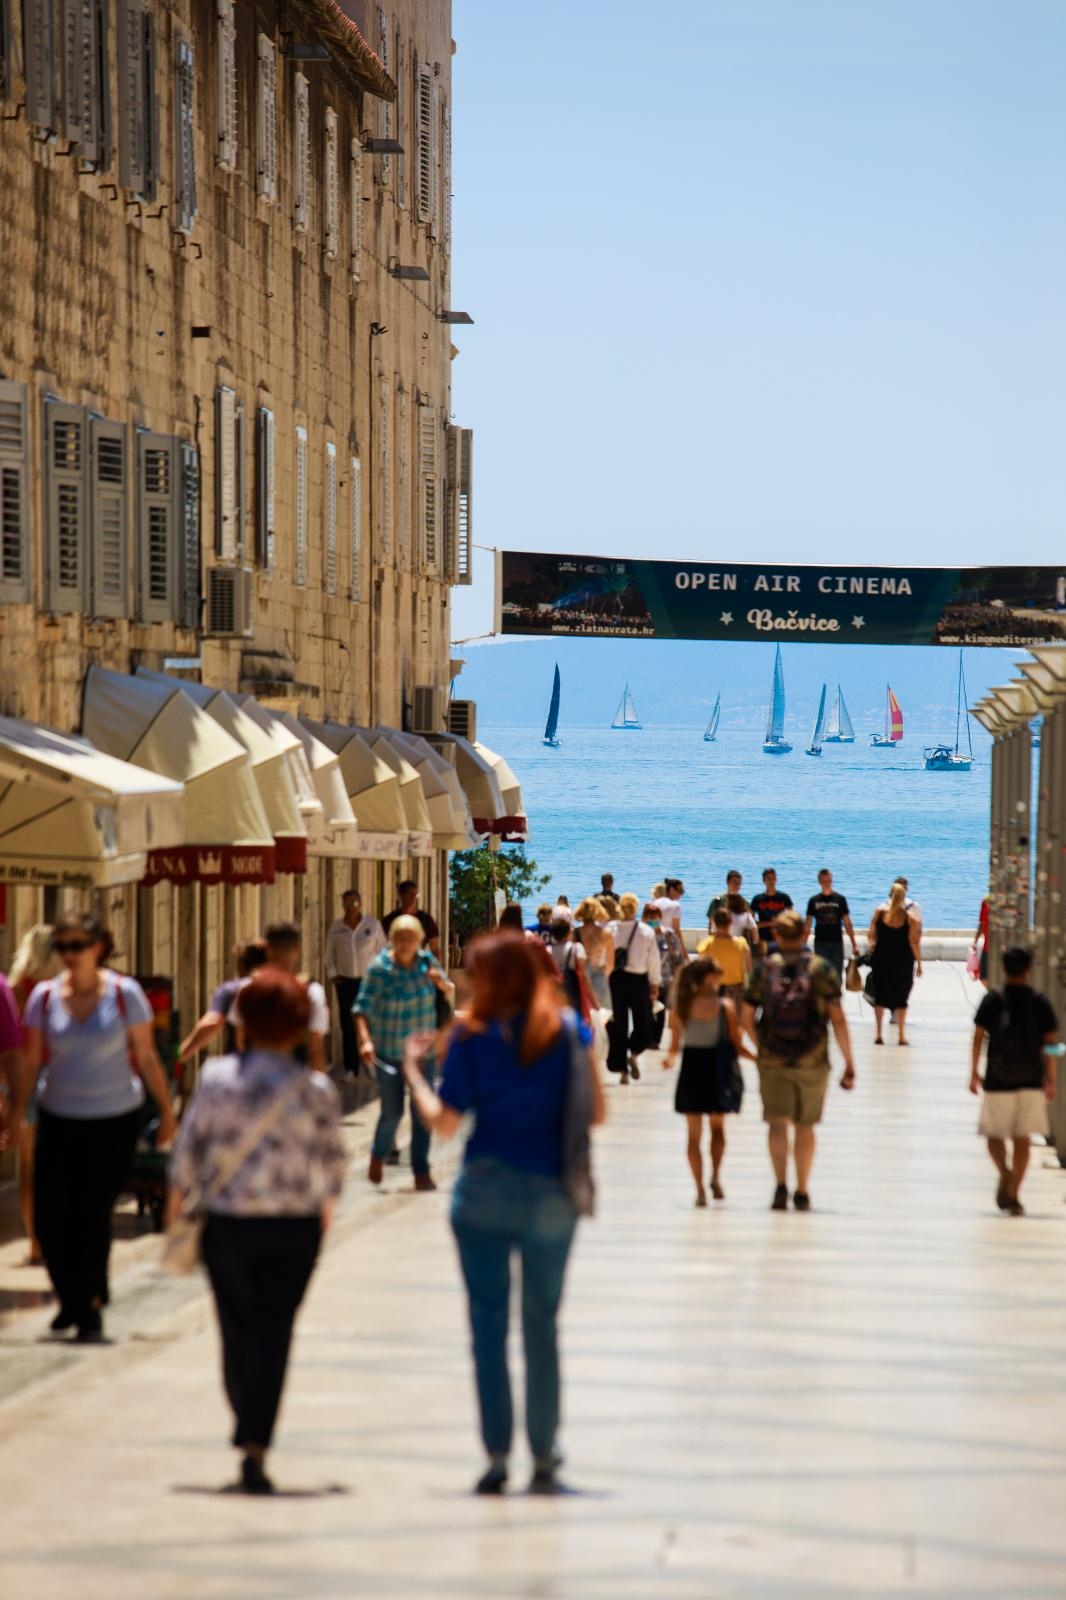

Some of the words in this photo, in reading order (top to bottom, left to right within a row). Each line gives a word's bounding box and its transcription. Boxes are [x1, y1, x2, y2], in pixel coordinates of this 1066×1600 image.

[674, 571, 737, 591] OPEN
[754, 574, 801, 592] AIR
[817, 575, 913, 595] CINEMA
[746, 608, 841, 632] Bačvice
[551, 624, 656, 635] www.zlatnavrata.hr
[939, 632, 1064, 645] www.kinomediteranh
